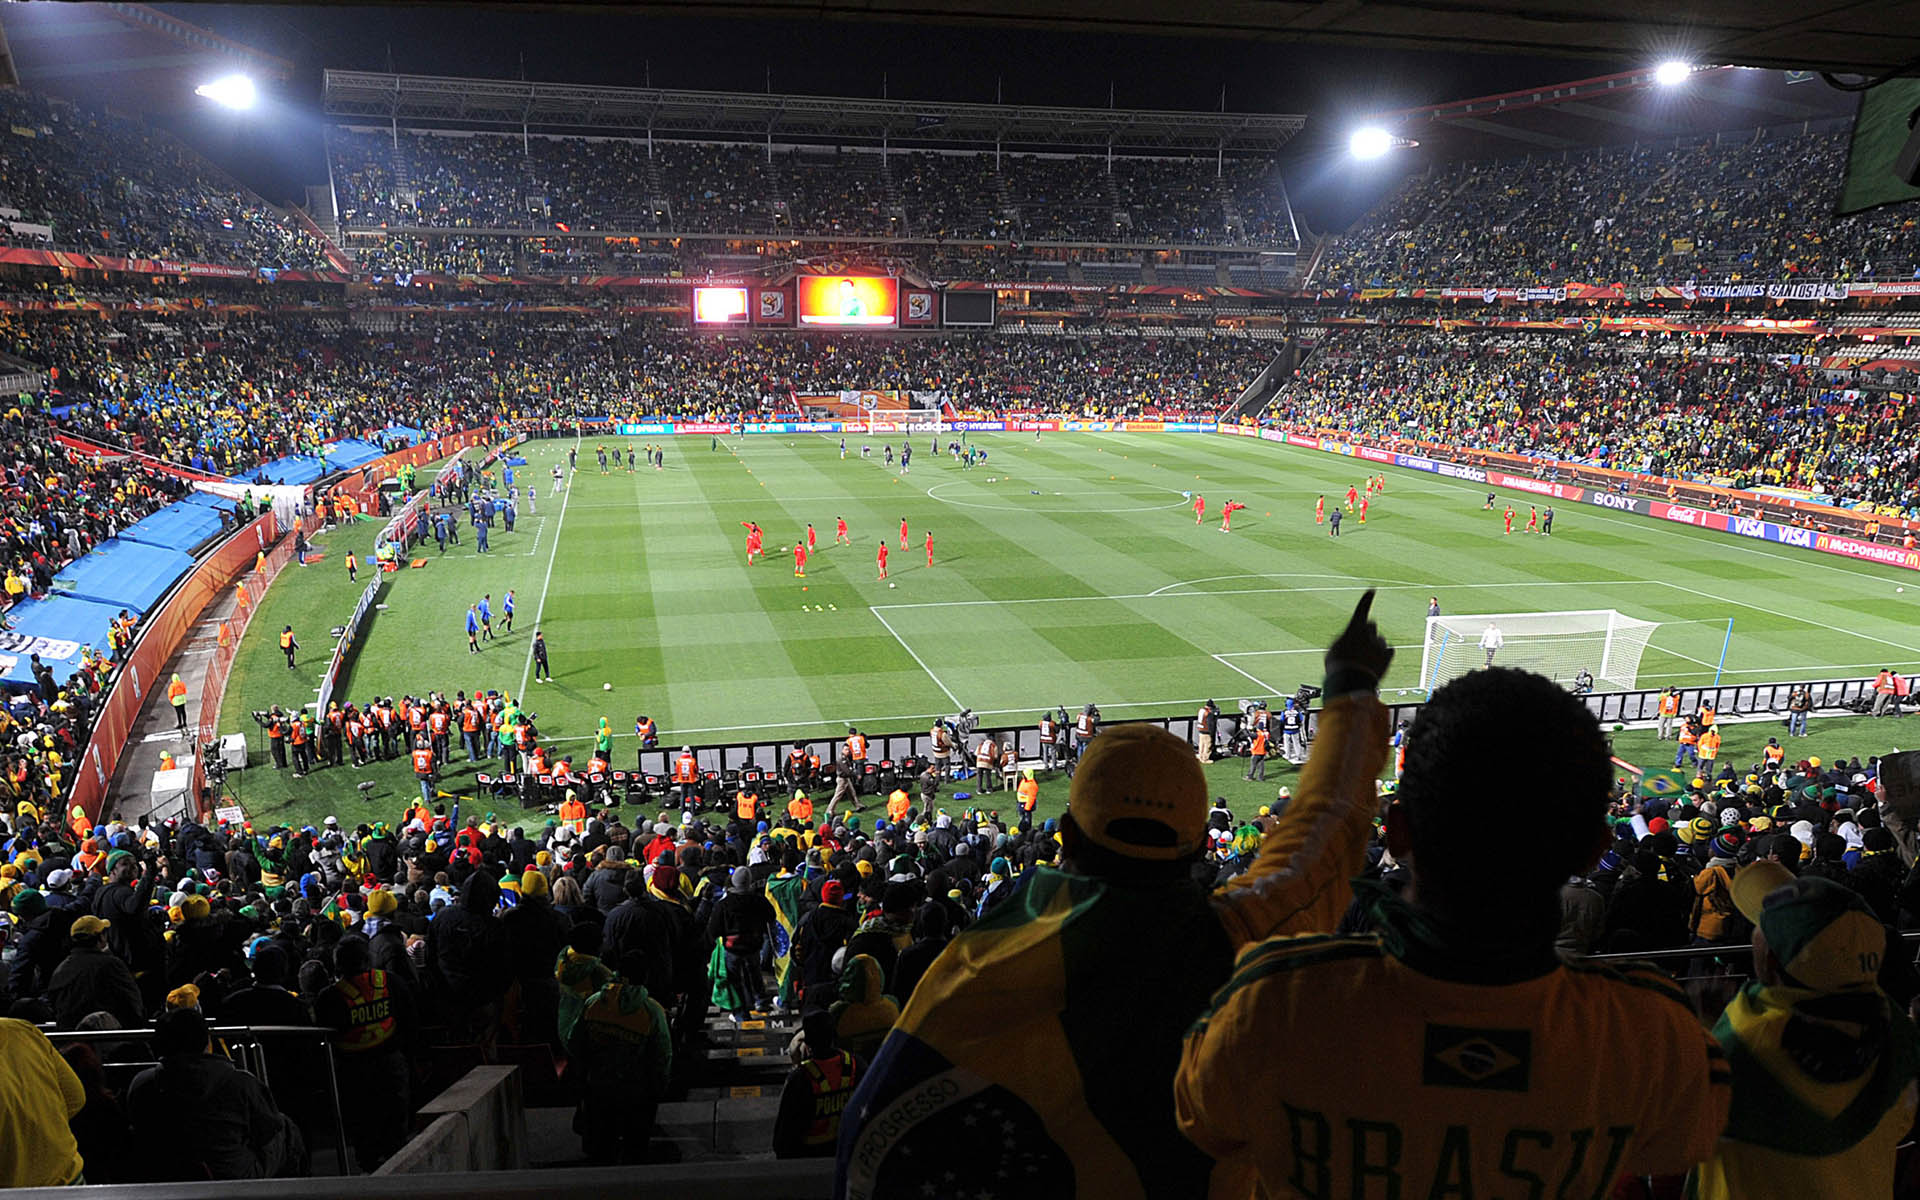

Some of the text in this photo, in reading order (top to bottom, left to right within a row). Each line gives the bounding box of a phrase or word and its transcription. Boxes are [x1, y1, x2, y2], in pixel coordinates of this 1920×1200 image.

[1701, 284, 1766, 298] SEXMACHINES
[1593, 491, 1638, 512] SONY
[1733, 517, 1765, 539] VISA
[1777, 525, 1810, 548] VISA
[1829, 538, 1905, 563] McDonald's
[1857, 952, 1881, 973] 10
[350, 999, 390, 1025] POLICE
[858, 1078, 959, 1168] PROGRESSO
